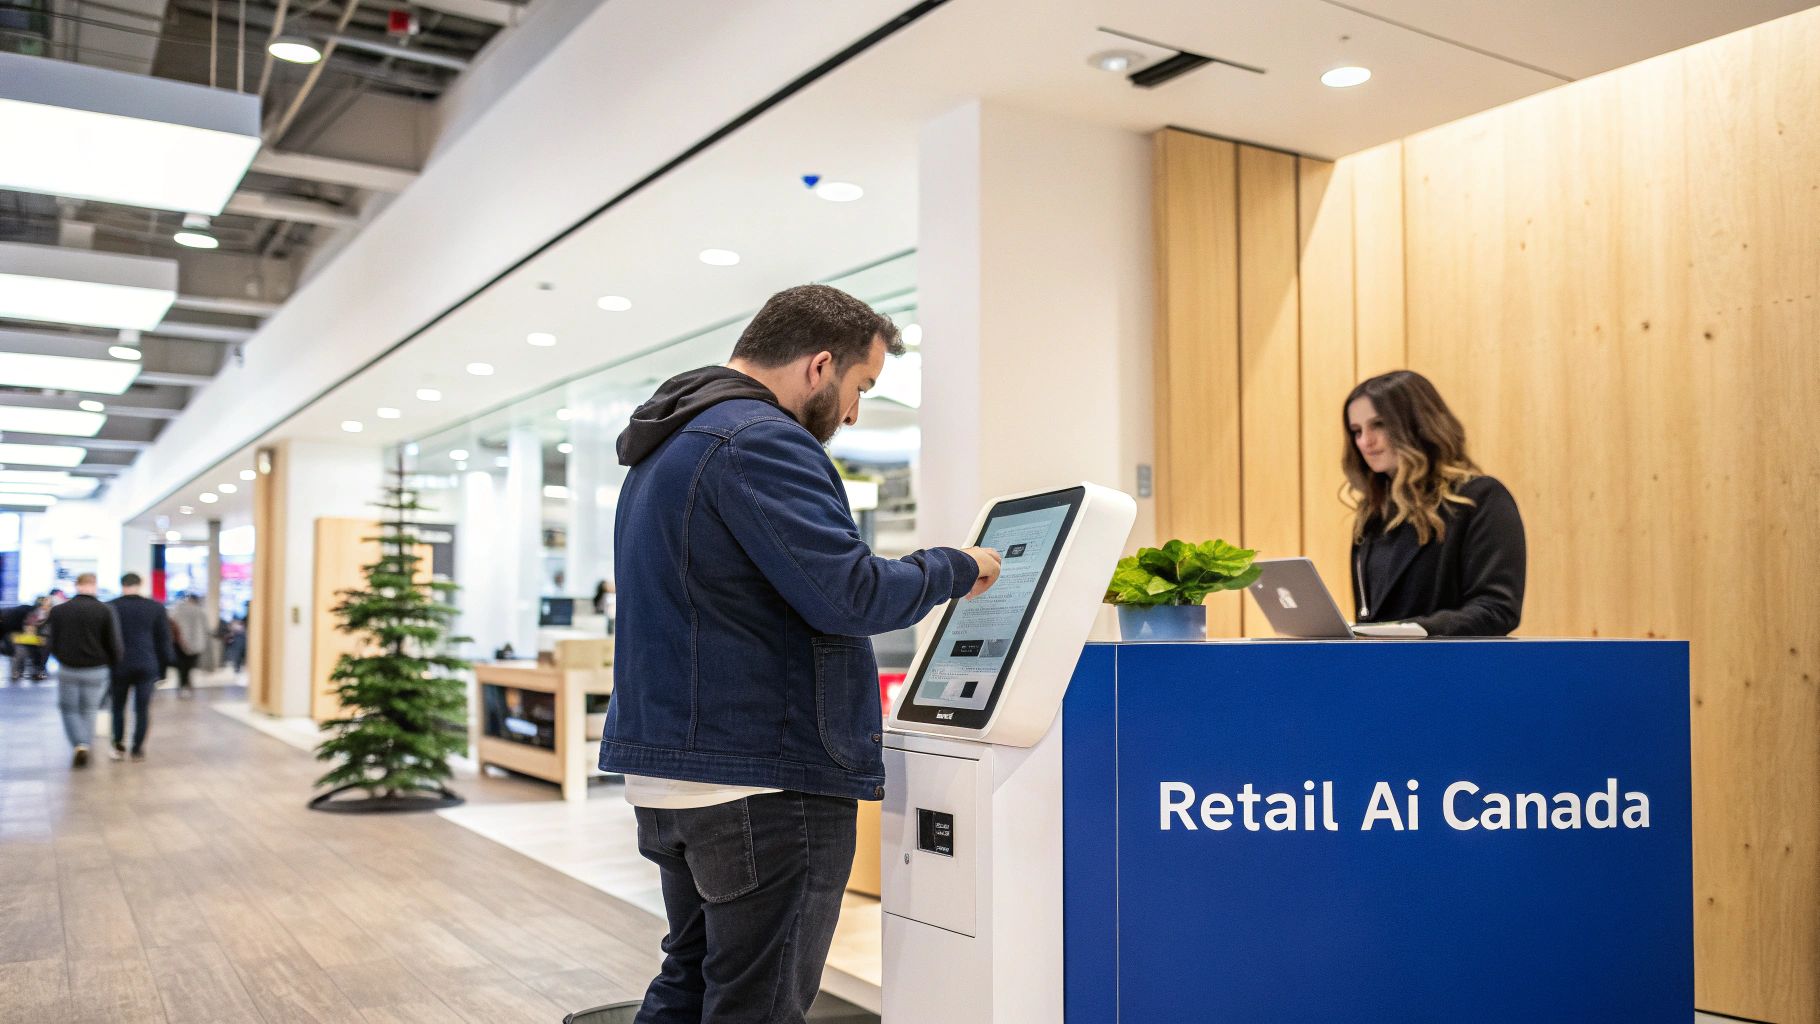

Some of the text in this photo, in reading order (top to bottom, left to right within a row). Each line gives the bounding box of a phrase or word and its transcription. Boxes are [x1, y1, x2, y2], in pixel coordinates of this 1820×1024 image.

[1160, 778, 1650, 832] Retail Ai Canada
